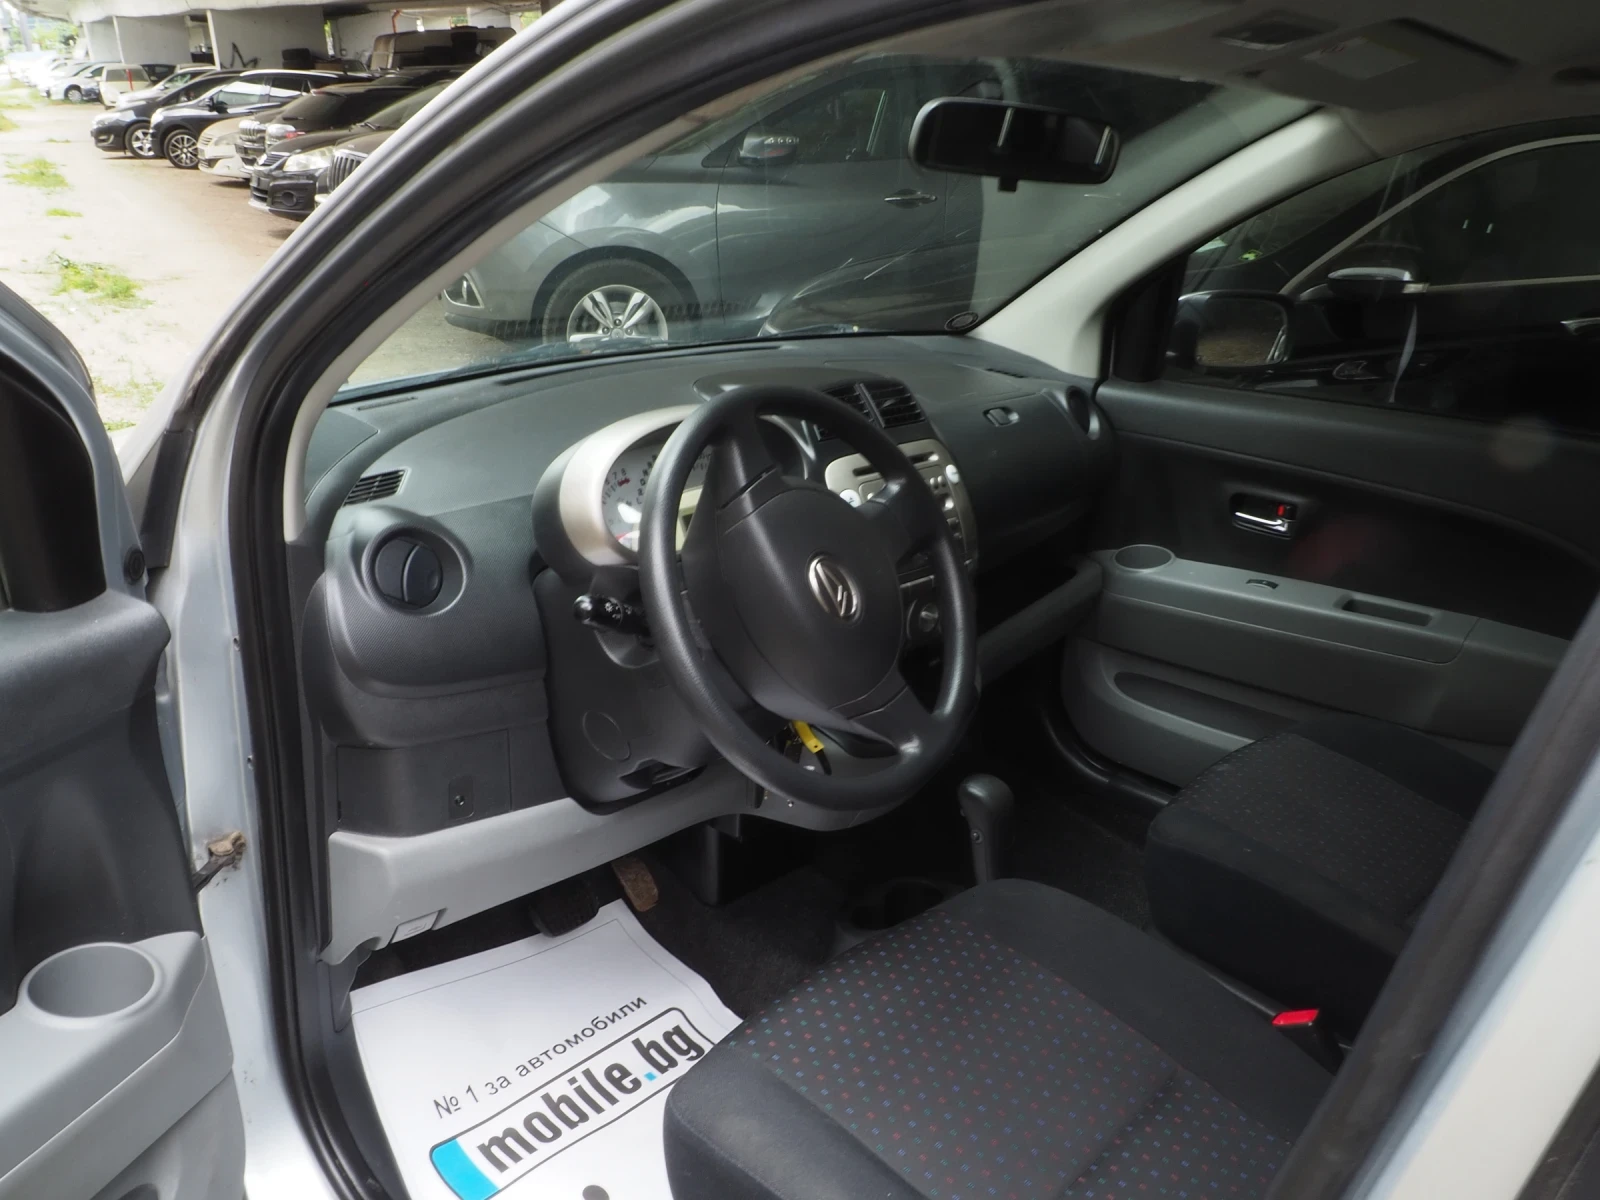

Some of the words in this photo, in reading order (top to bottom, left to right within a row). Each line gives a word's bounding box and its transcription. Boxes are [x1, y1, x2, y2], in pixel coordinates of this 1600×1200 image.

[465, 1084, 479, 1103] 1
[484, 1075, 512, 1096] за
[515, 997, 648, 1077] автомобили
[476, 1024, 705, 1173] mobile.bg
